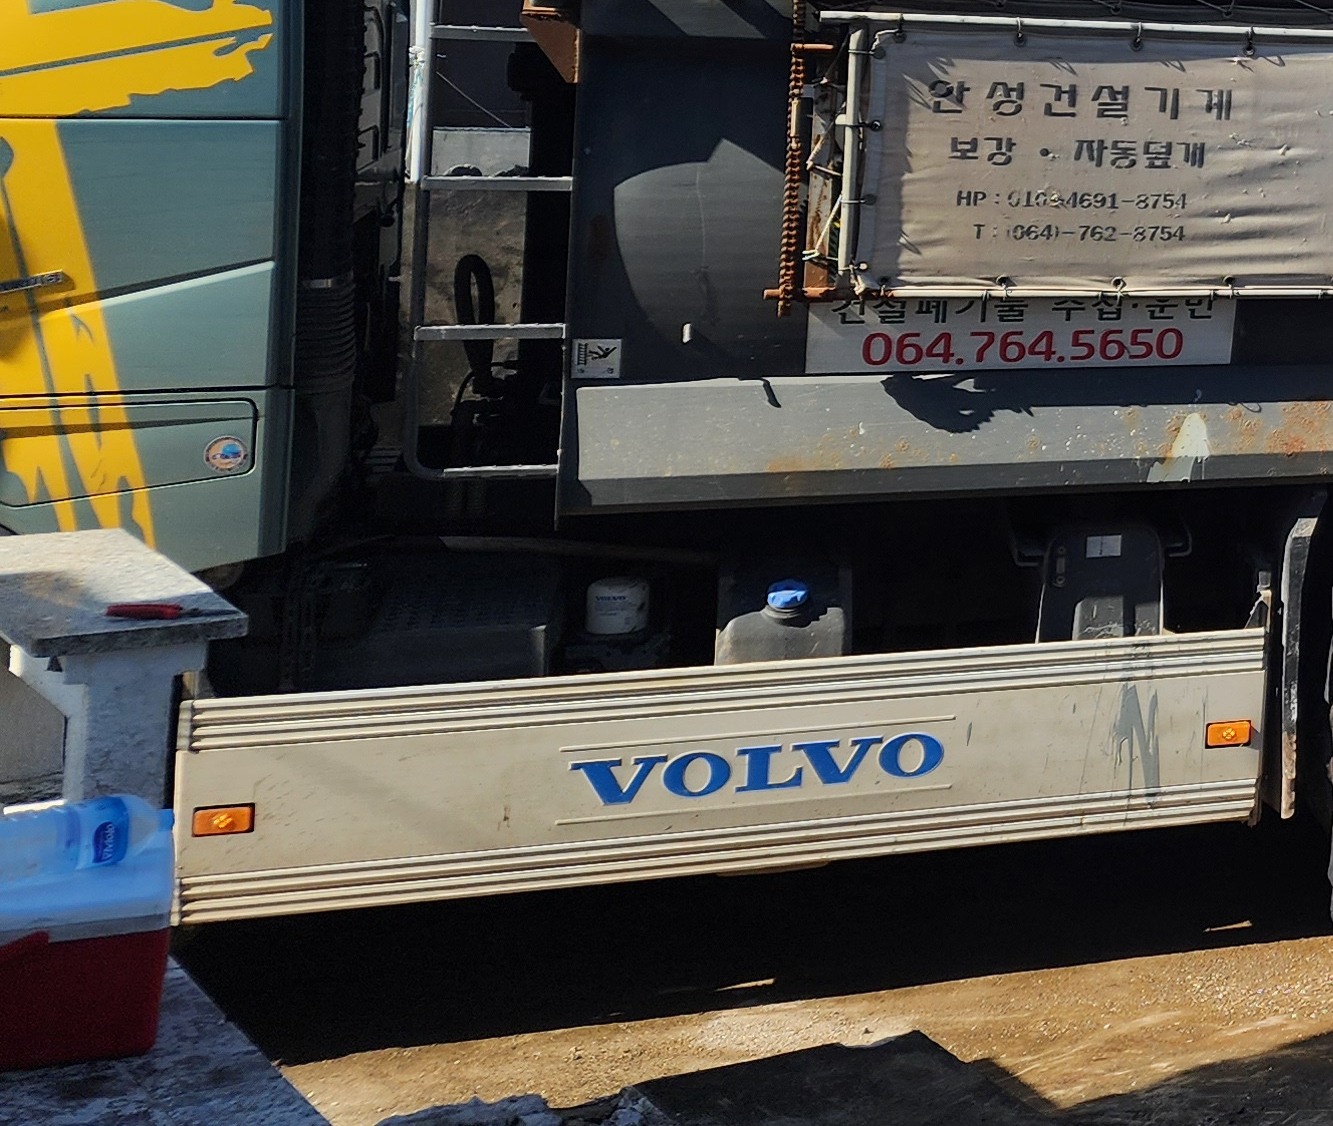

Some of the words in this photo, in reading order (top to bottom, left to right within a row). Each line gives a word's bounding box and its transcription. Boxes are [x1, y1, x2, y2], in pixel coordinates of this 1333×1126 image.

[948, 136, 1017, 166] 보강
[1073, 138, 1206, 169] 자동덮개
[862, 327, 1184, 365] 064.764.5650
[569, 731, 945, 806] VOLVO
